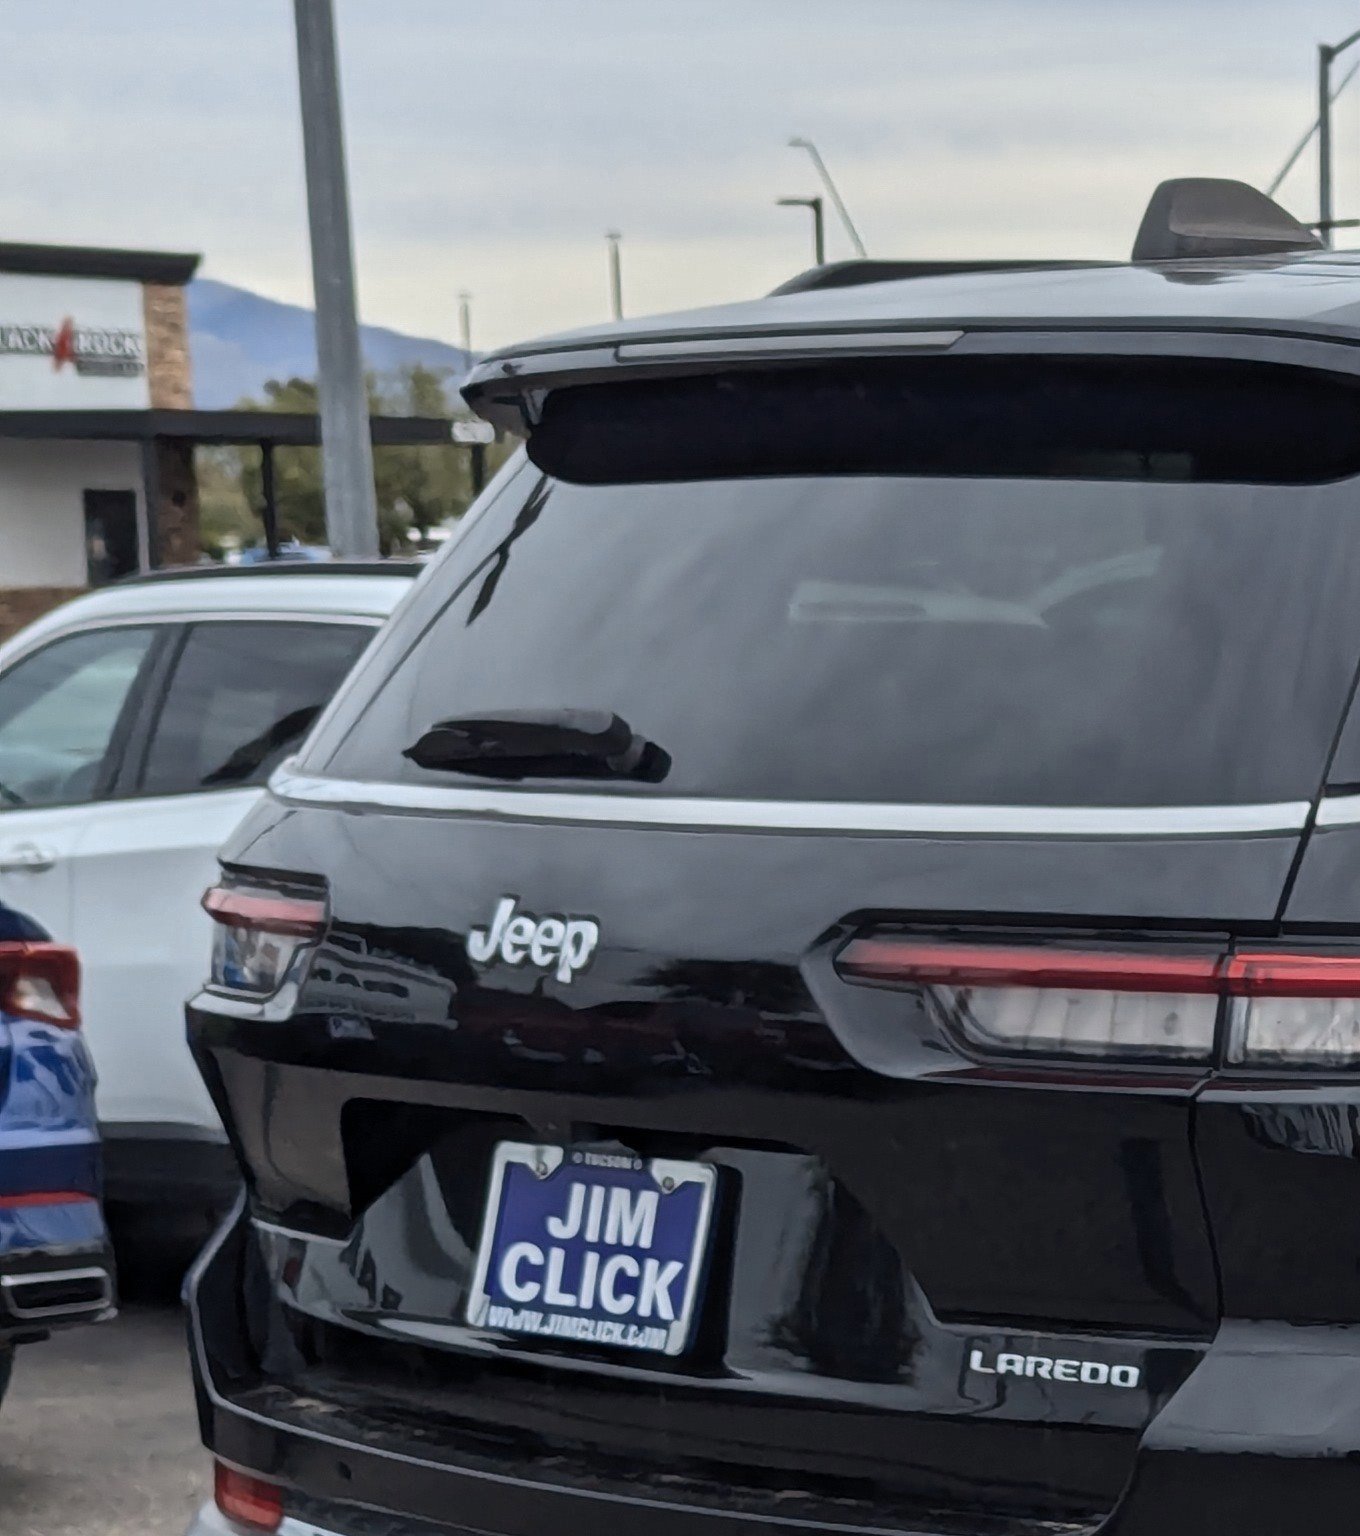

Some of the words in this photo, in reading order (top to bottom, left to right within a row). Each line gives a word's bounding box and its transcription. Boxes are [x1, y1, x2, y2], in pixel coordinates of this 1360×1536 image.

[468, 897, 599, 984] Jeep
[546, 1183, 660, 1249] JIM
[500, 1242, 685, 1321] CLICK
[969, 1350, 1140, 1388] LAREDO
